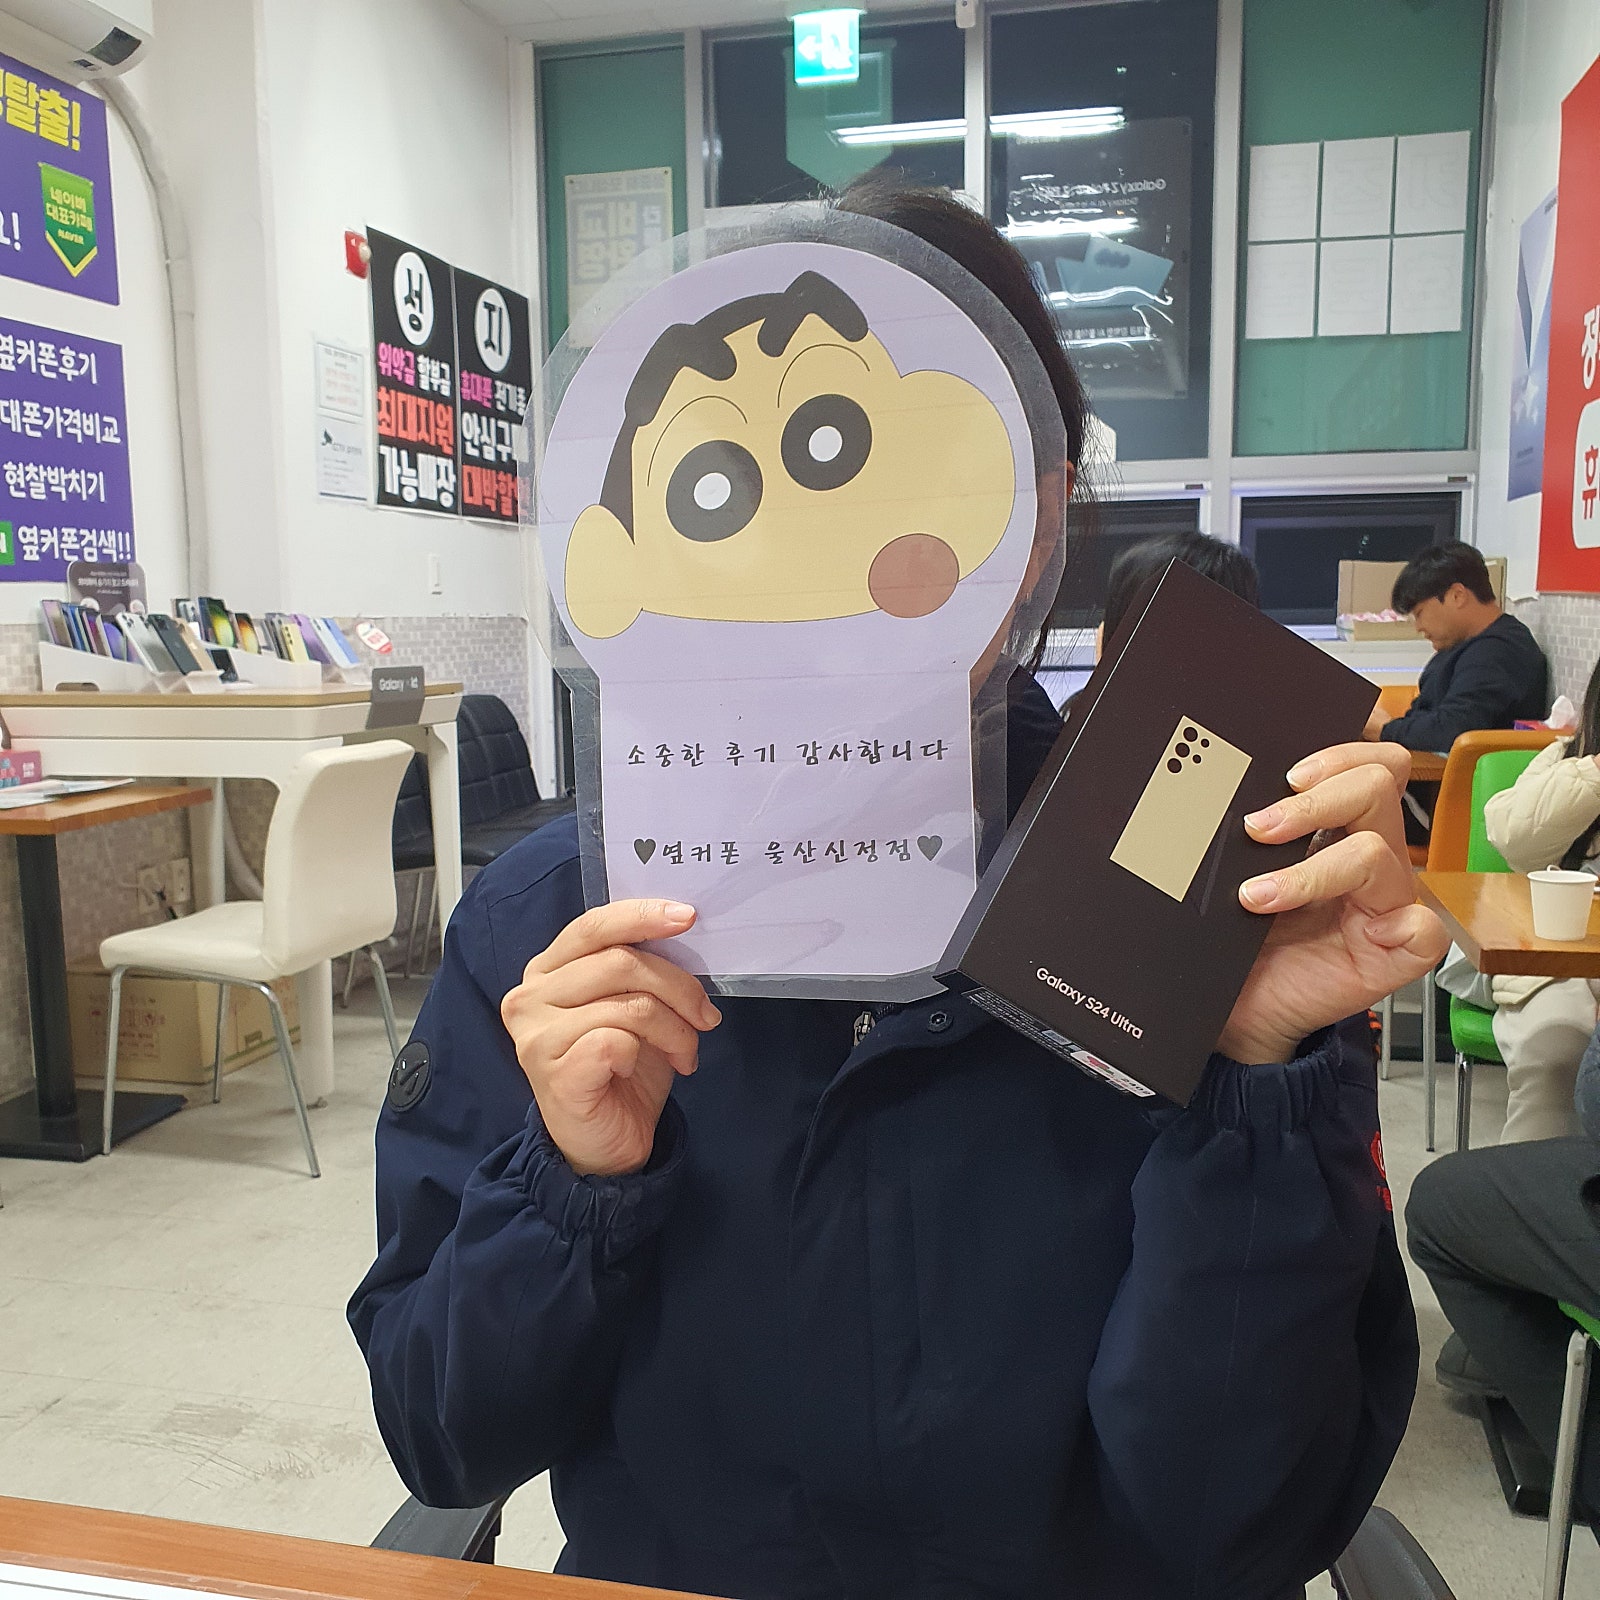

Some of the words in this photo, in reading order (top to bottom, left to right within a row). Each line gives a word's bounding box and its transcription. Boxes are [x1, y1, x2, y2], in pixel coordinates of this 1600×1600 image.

[0, 68, 81, 151] 탈출!
[46, 202, 93, 232] 대표카페
[50, 186, 87, 213] 네이버
[404, 268, 424, 332] 성
[483, 301, 502, 356] 지
[0, 333, 97, 385] 옆커폰후기
[378, 342, 415, 387] 위약금
[417, 354, 450, 398] 할부금
[461, 369, 493, 409] 휴대폰
[0, 399, 121, 444] 대폰가격비교
[377, 386, 454, 456] 최대지원
[3, 461, 105, 502] 현찰박치기
[379, 445, 456, 508] 가능매장
[18, 525, 131, 562] 옆커폰검색!!
[627, 743, 705, 767] 소중한
[725, 741, 776, 766] 후기
[796, 739, 949, 766] 감사합니다
[661, 840, 740, 865] 옆커폰
[764, 838, 911, 865] 울산신정점
[1036, 967, 1087, 1006] Galaxy
[1085, 997, 1110, 1019] S24
[1110, 1011, 1144, 1039] Ultra
